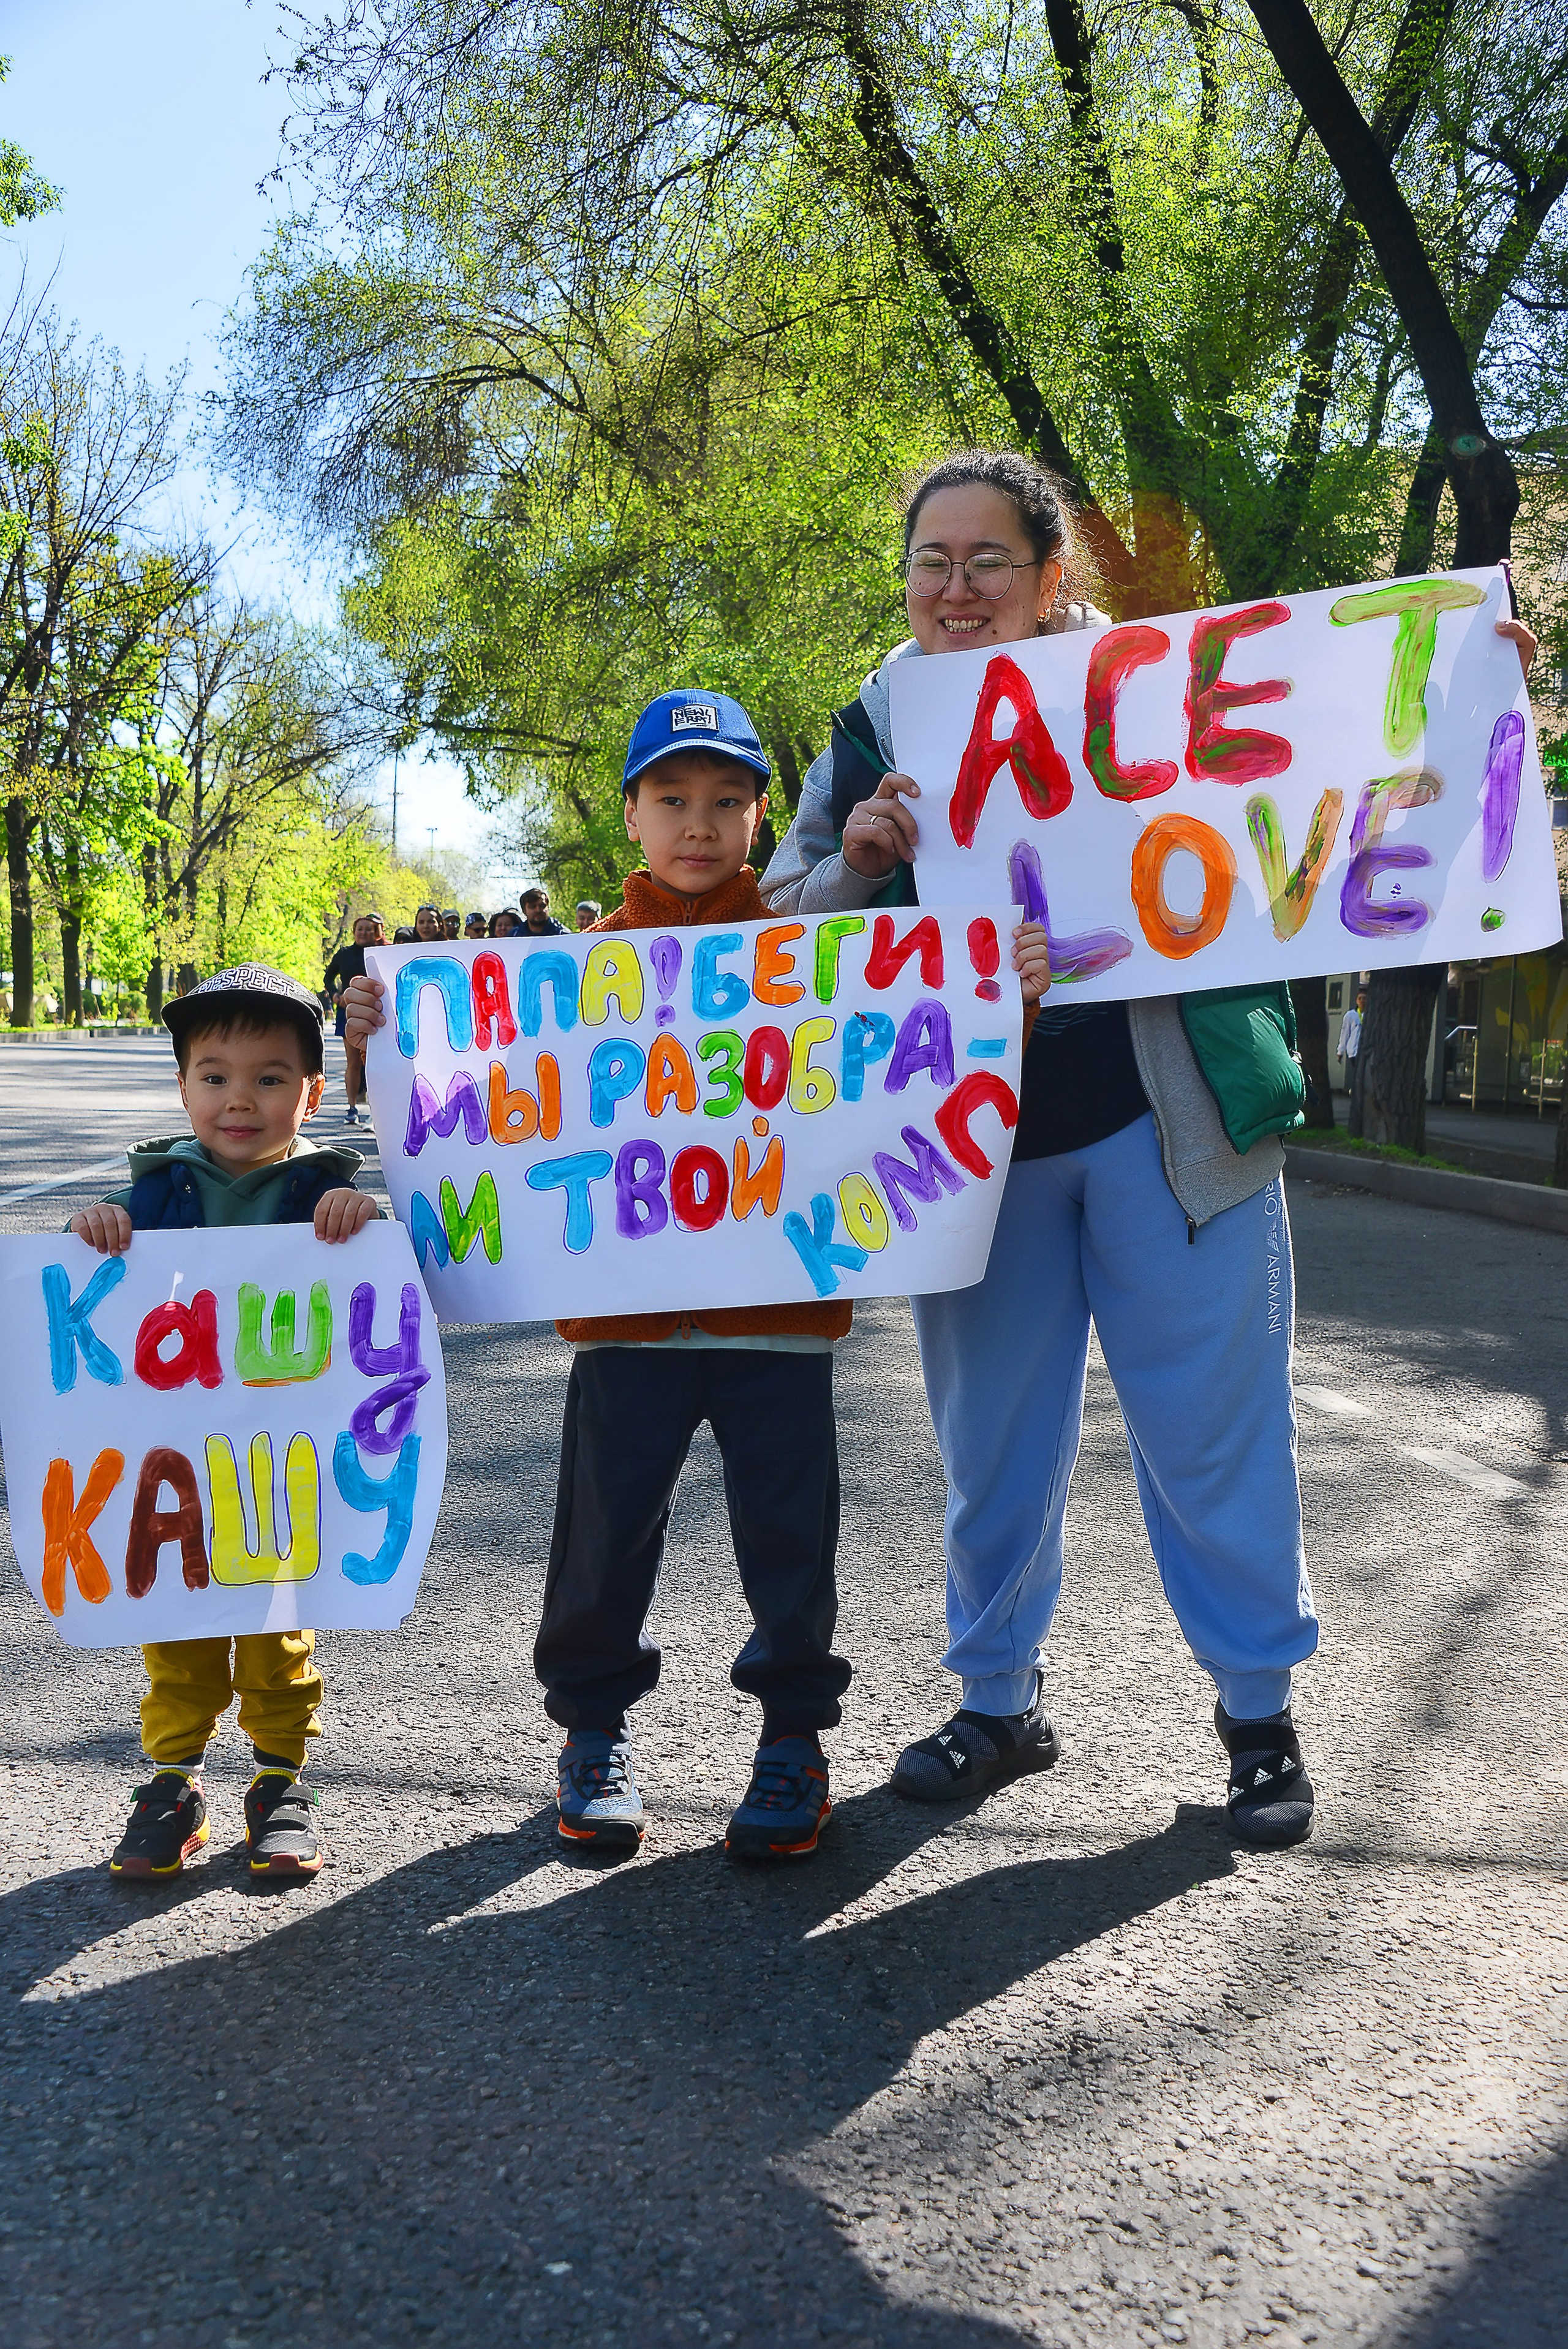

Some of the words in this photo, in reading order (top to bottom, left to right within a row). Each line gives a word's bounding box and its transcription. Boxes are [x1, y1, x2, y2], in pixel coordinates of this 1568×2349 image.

[525, 1115, 785, 1254] ТВОЙ
[1267, 1254, 1282, 1335] ARMANI
[42, 1430, 422, 1618] КАШУ
[949, 1751, 960, 1769] adidas
[1253, 1774, 1273, 1785] adidas
[1281, 1762, 1296, 1773] adidas
